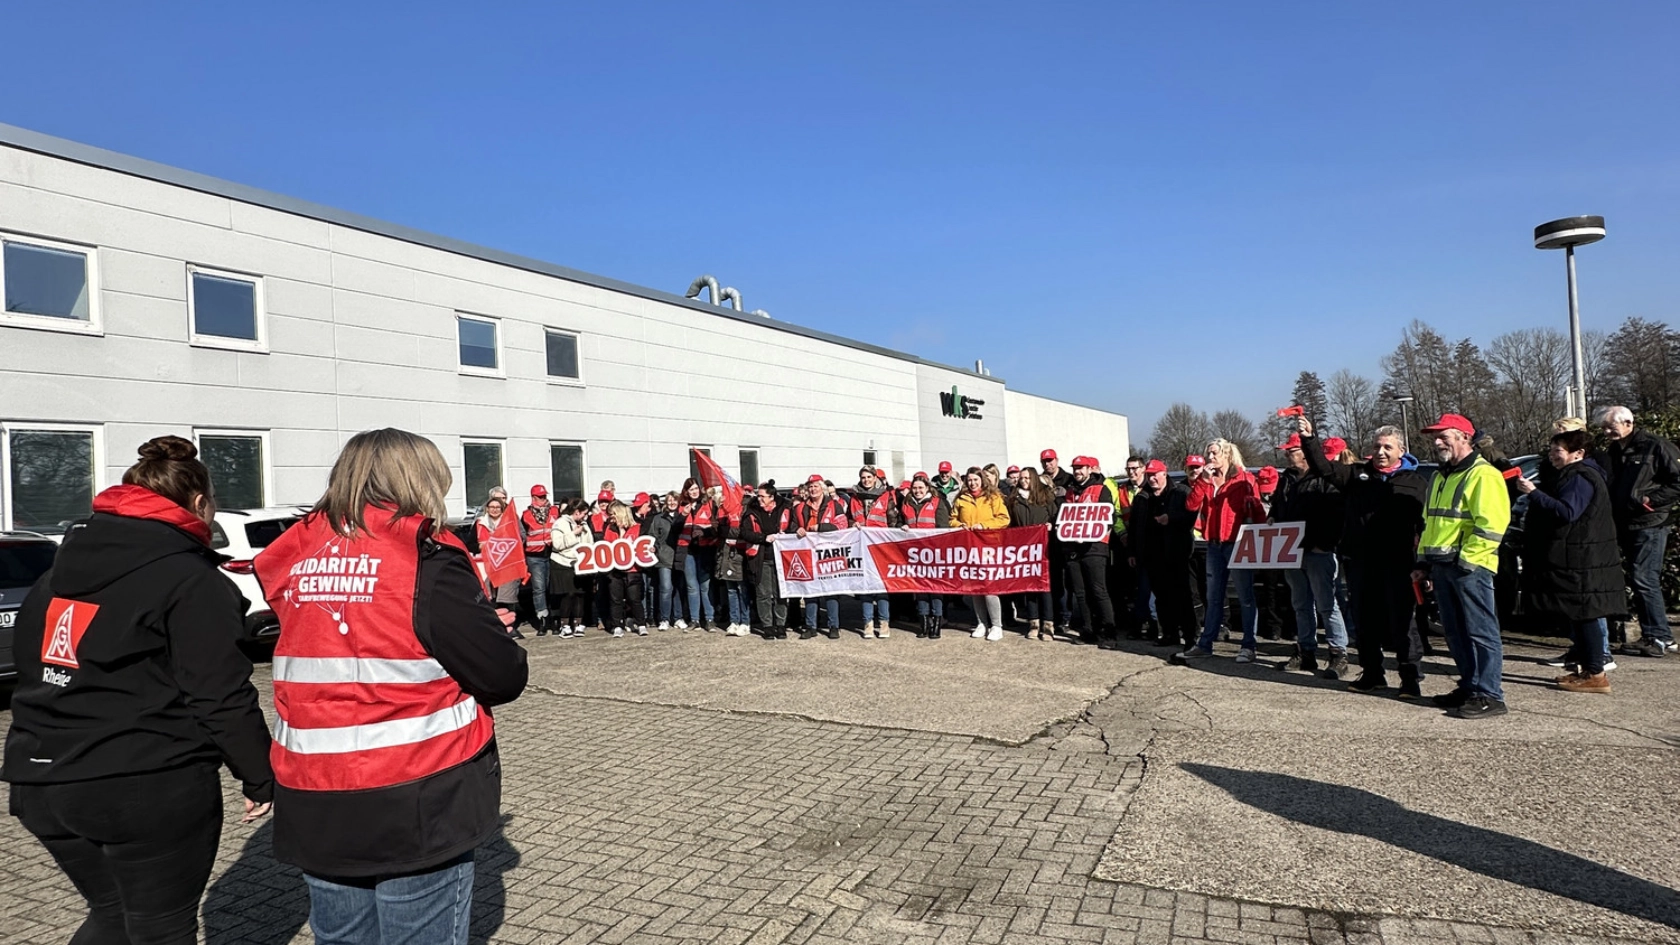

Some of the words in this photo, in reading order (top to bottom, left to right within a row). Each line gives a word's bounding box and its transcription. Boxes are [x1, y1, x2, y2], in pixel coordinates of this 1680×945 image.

[1060, 505, 1111, 521] MEHR
[1060, 522, 1104, 539] GELD
[816, 546, 851, 560] TARIF
[1233, 527, 1300, 563] ATZ
[576, 539, 653, 571] 200€
[907, 544, 1043, 565] SOLIDARISCH
[290, 554, 381, 575] OLIDARITÄT
[887, 564, 956, 579] ZUKUNFT
[959, 564, 1042, 581] GESTALTEN
[299, 576, 378, 593] GEWINNT
